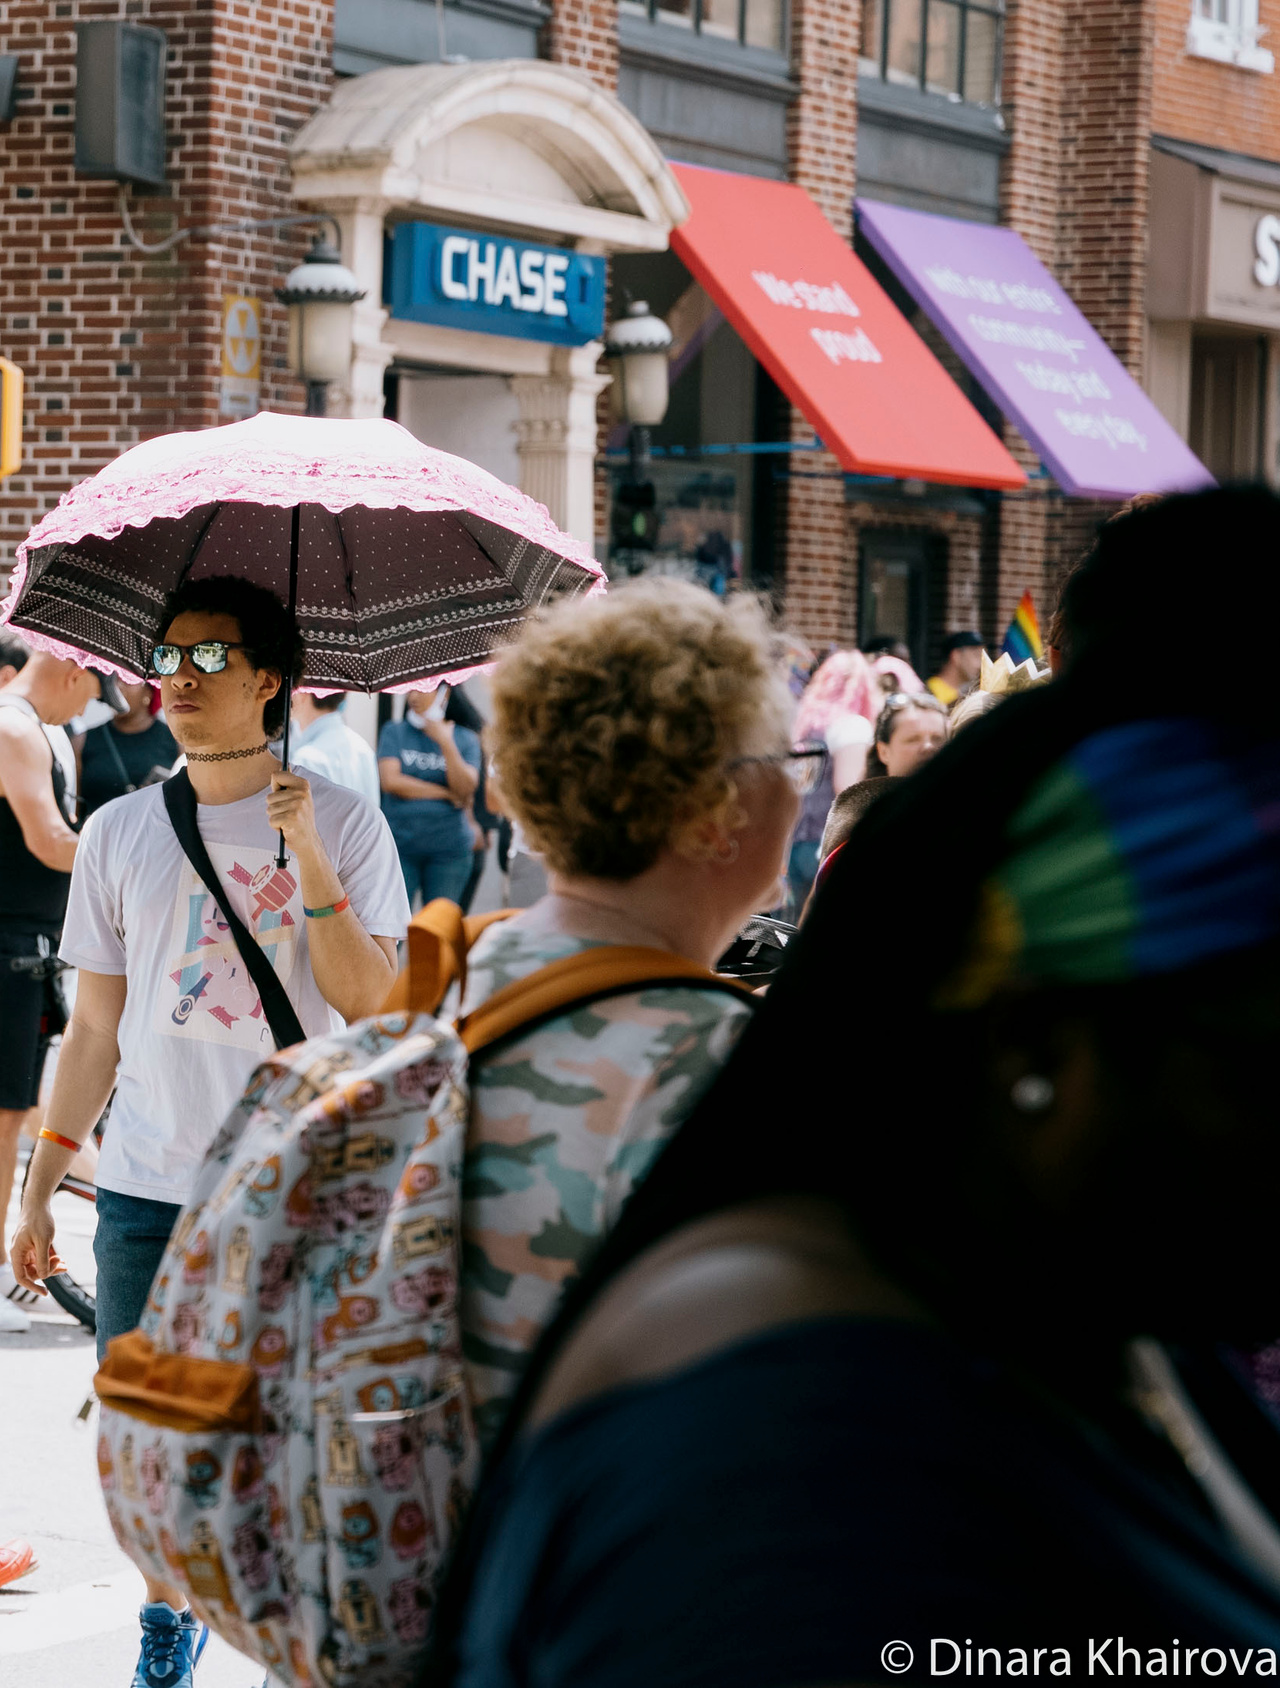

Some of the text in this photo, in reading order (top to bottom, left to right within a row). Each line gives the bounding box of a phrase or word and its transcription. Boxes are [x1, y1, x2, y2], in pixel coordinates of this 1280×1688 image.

[441, 236, 569, 317] CHASE
[751, 270, 861, 318] We stand
[809, 326, 883, 366] proud
